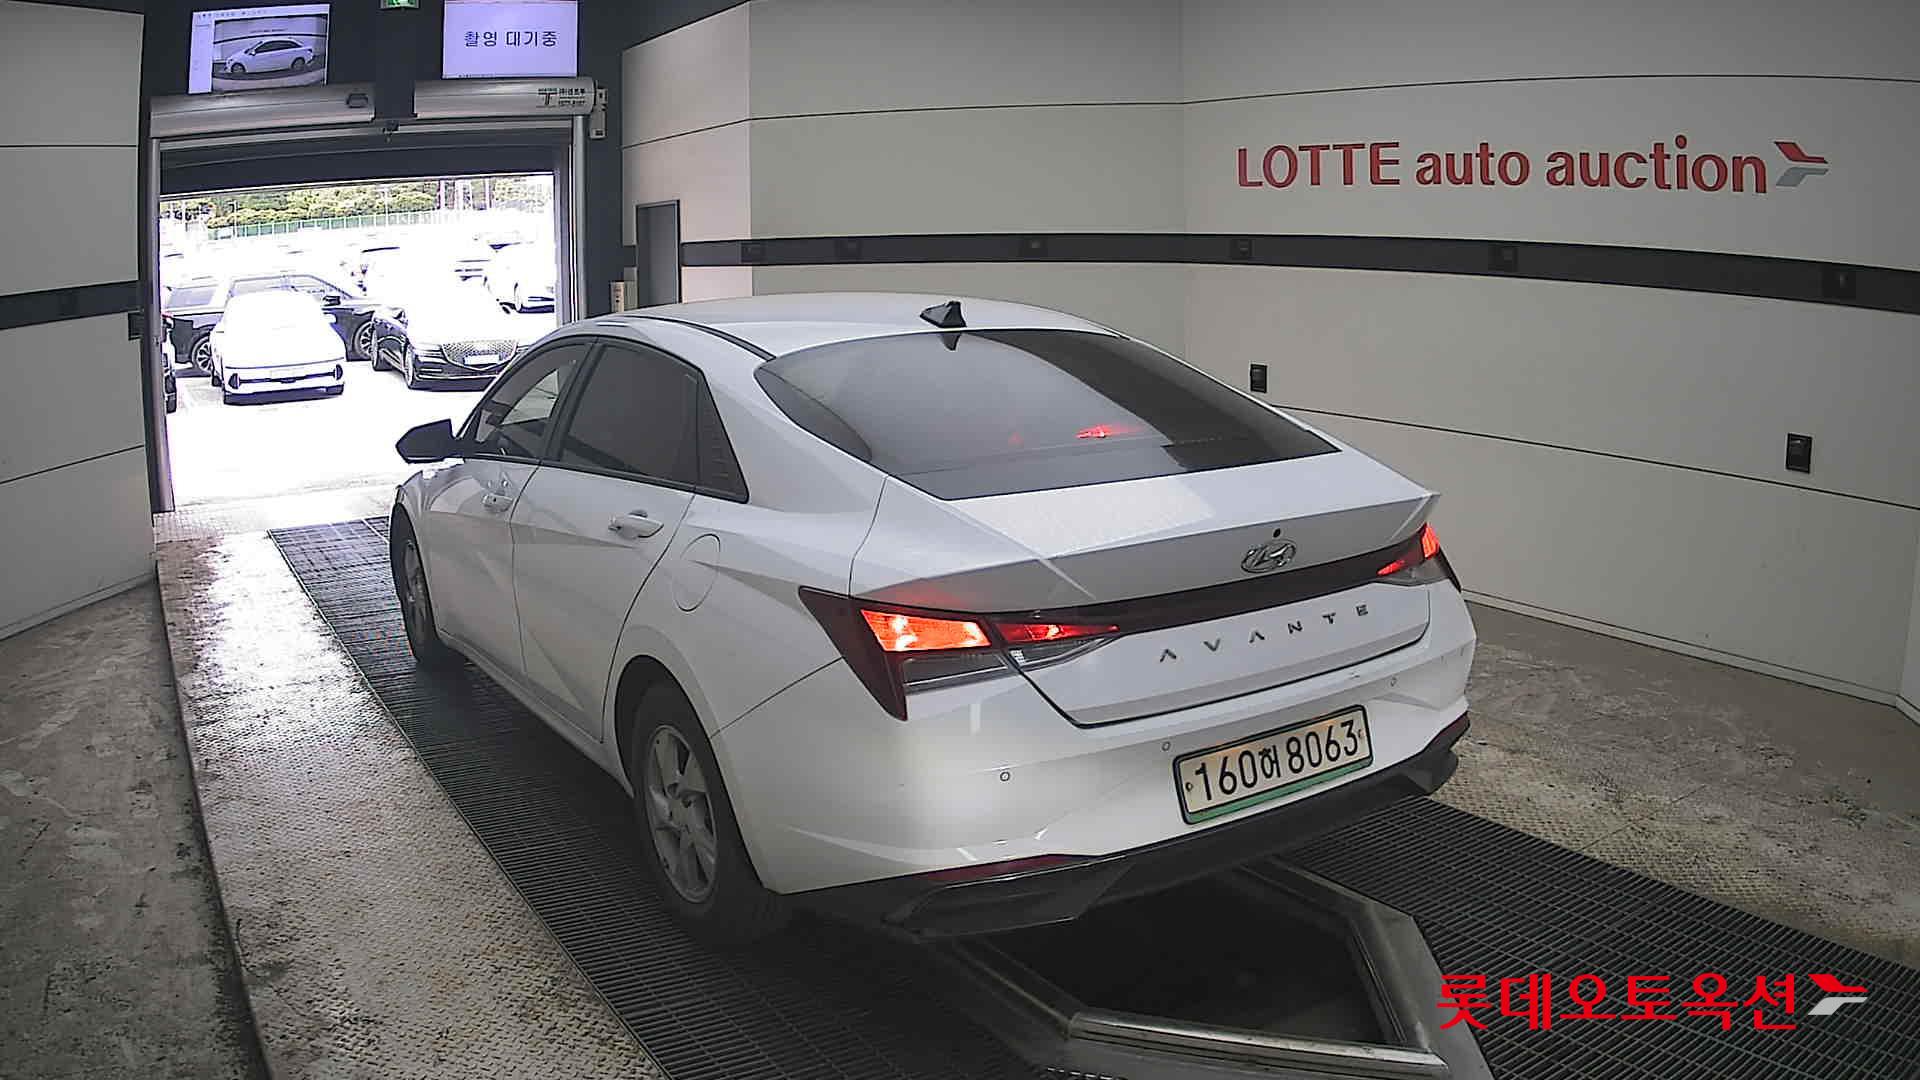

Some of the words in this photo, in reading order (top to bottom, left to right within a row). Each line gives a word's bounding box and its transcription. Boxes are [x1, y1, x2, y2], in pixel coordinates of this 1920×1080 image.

[464, 30, 498, 48] 촬영
[504, 30, 558, 48] 대기중
[1236, 141, 1401, 189] LOTTE
[1415, 142, 1531, 186] auto
[1545, 134, 1767, 194] auction
[1159, 604, 1369, 663] AVANTE
